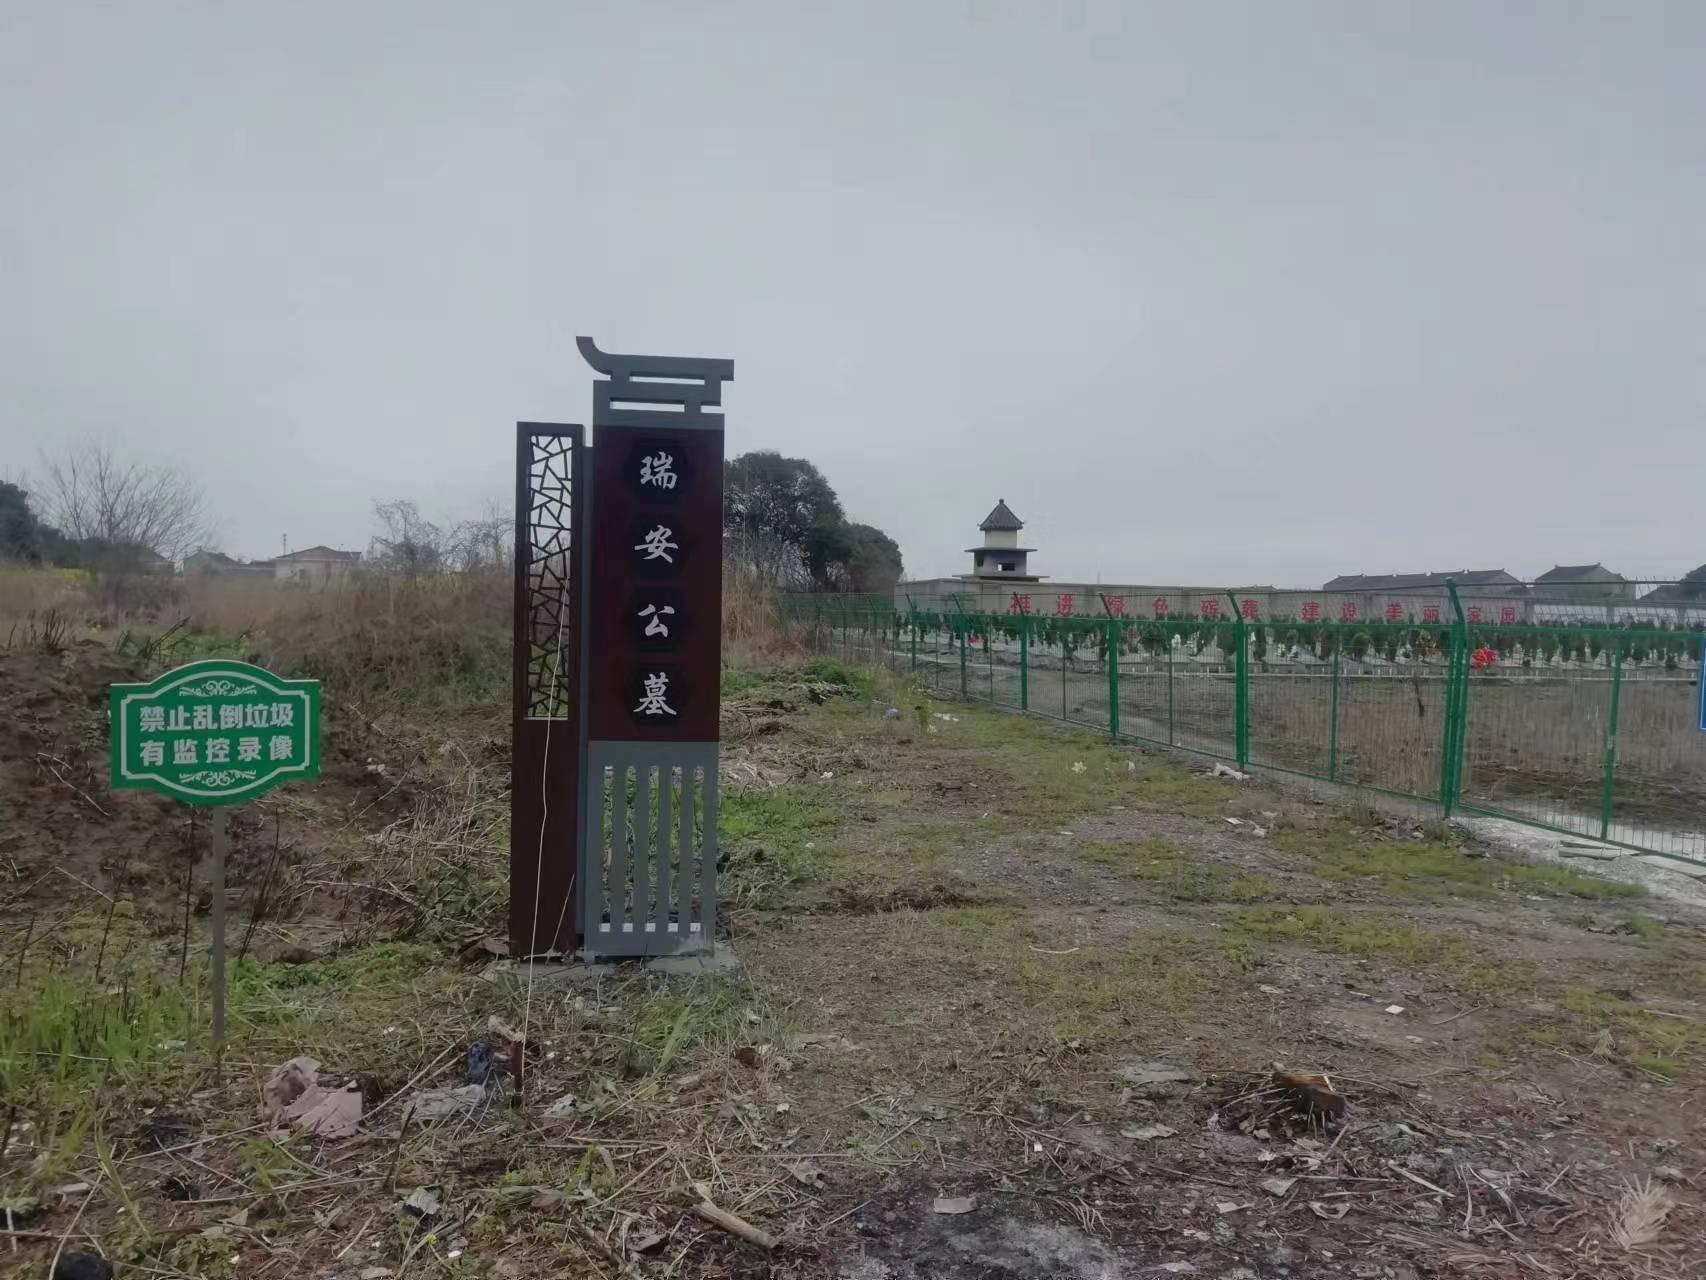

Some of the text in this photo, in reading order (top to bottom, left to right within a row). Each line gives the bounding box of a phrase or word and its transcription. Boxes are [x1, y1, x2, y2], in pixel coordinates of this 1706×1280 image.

[633, 451, 679, 716] 瑞安公墓
[139, 703, 294, 732] 禁止乱倒垃圾
[139, 735, 293, 766] 有监控录像
